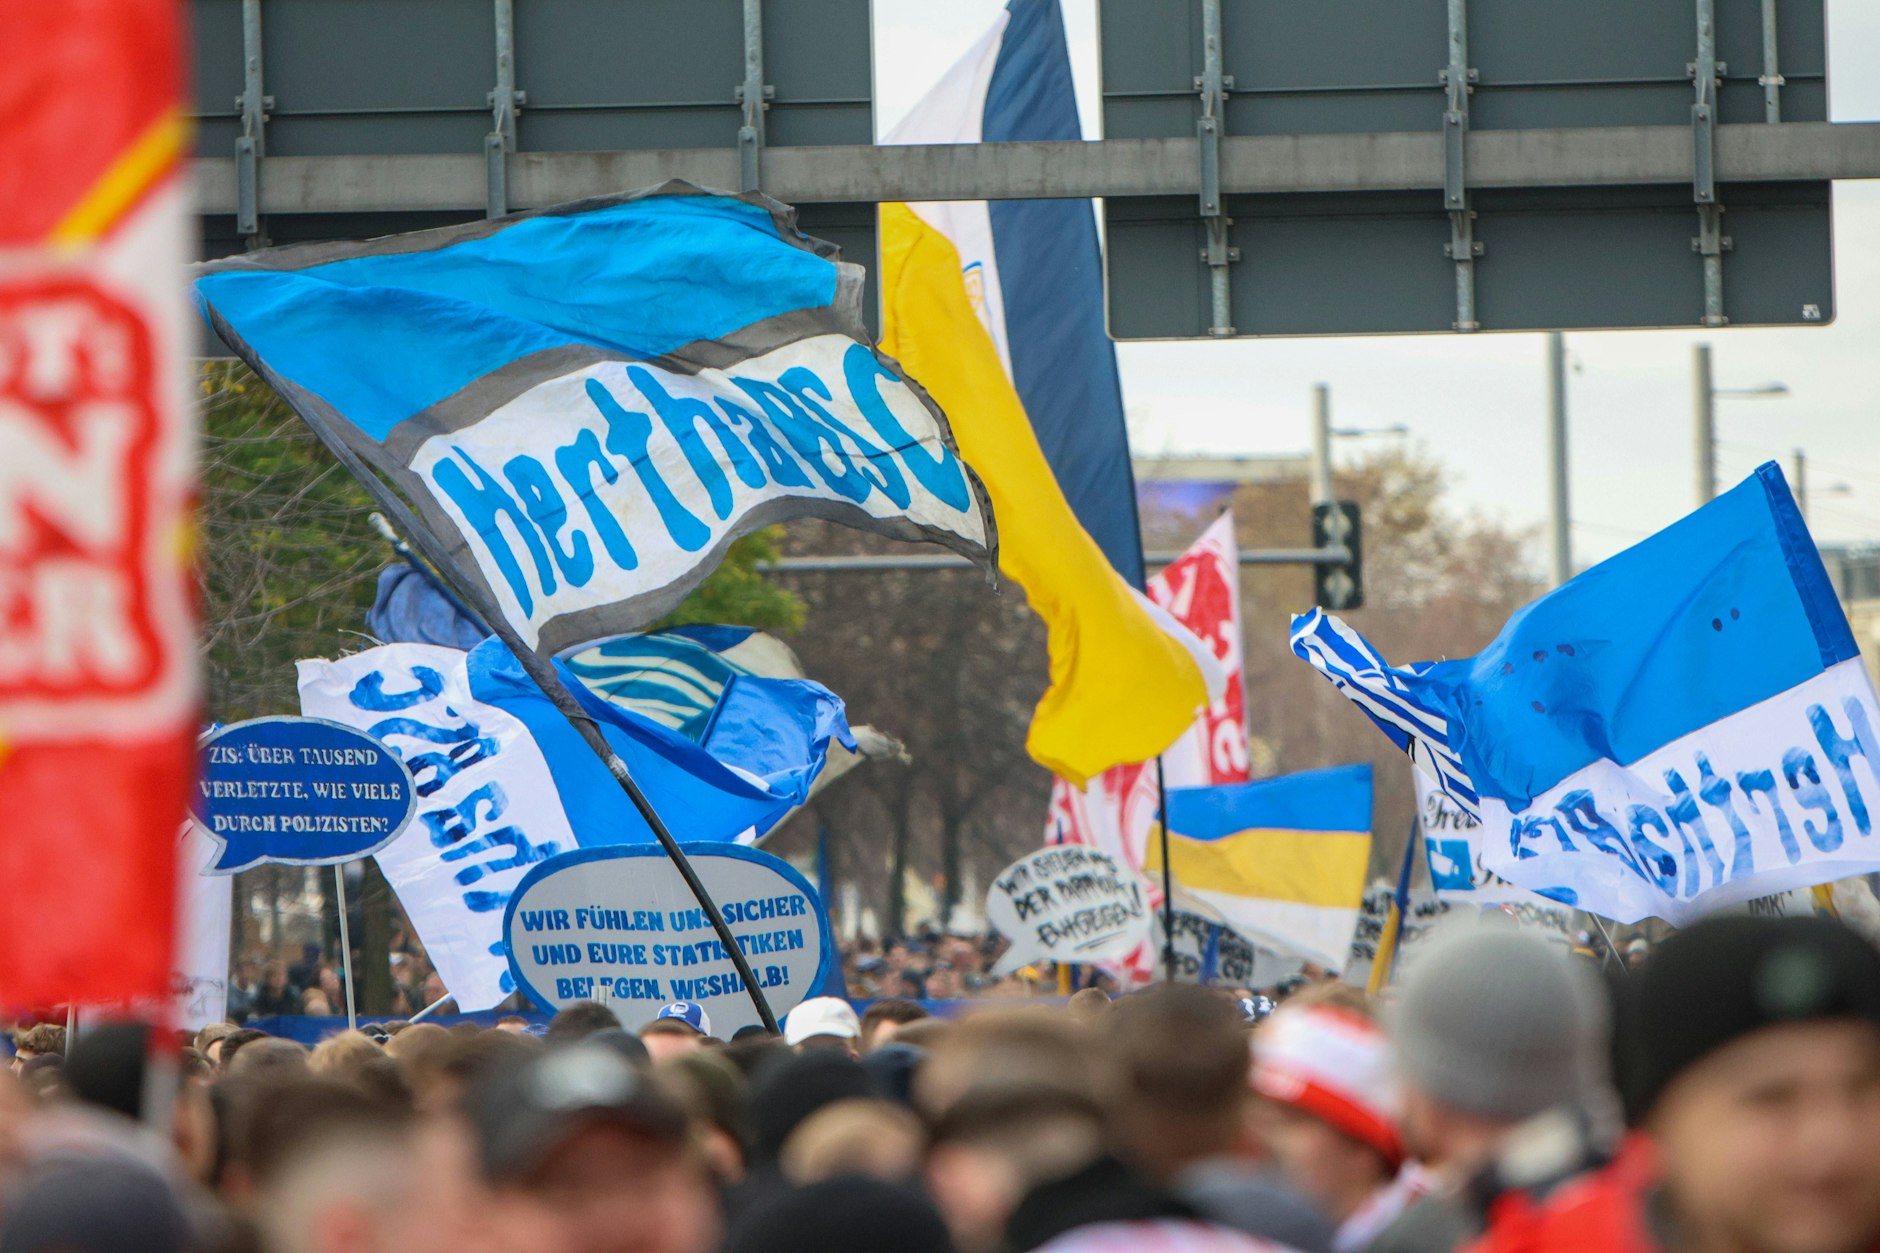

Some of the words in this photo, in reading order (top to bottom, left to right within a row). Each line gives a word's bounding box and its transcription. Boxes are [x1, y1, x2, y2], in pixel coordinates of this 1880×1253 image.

[209, 746, 243, 764] ZIS:
[247, 743, 296, 765] ÜBER
[299, 748, 378, 766] TAUSEND
[200, 780, 308, 800] VERLETZTE,
[312, 782, 347, 799] WIE
[351, 783, 401, 800] VIELE
[213, 815, 277, 832] DURCH
[281, 816, 389, 833] POLIZISTEN?
[520, 908, 569, 932] WIR
[576, 904, 664, 932] FÜHLEN
[722, 895, 806, 925] SICHER
[1013, 886, 1058, 922] DER
[532, 943, 582, 966] UND
[590, 943, 648, 965] EURE
[670, 965, 789, 1000] WESHLB!
